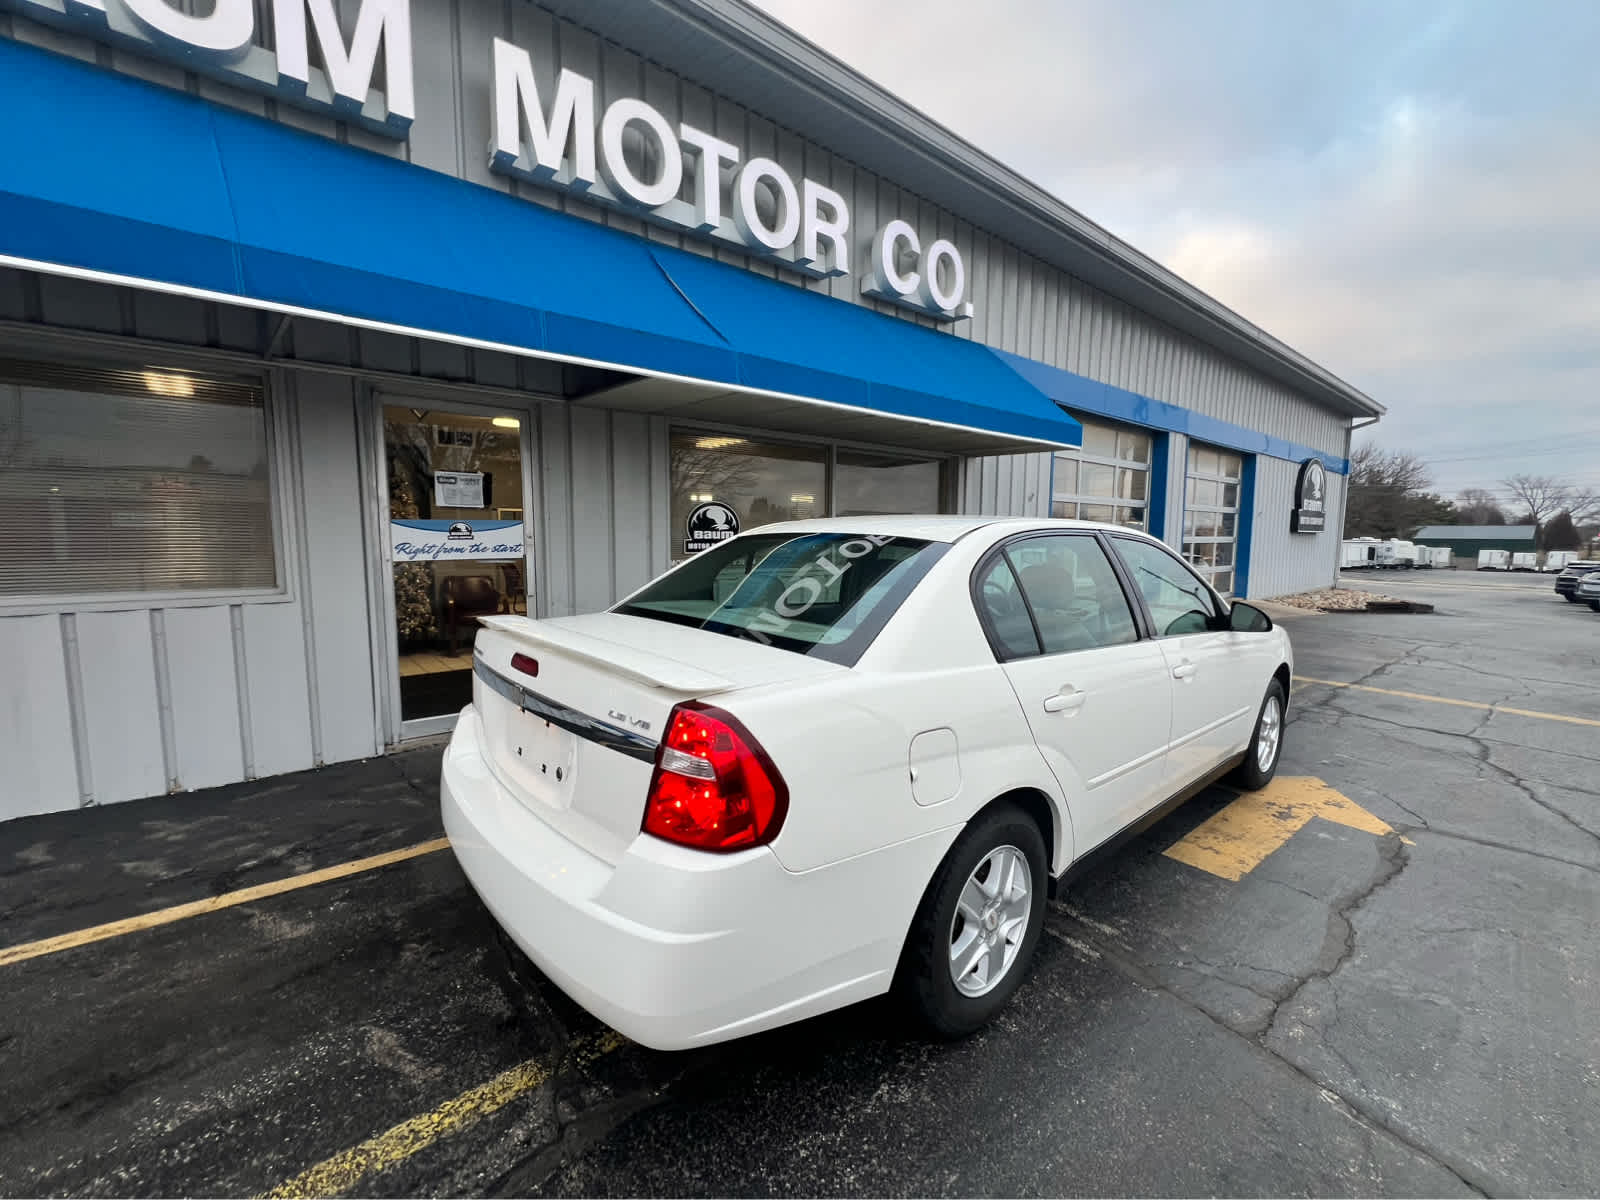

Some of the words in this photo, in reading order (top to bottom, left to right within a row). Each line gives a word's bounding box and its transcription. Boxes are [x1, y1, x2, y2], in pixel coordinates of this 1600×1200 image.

[493, 37, 849, 276] MOTOR
[876, 219, 973, 317] CO.
[394, 542, 435, 560] Right
[432, 543, 466, 559] from
[465, 542, 489, 553] the
